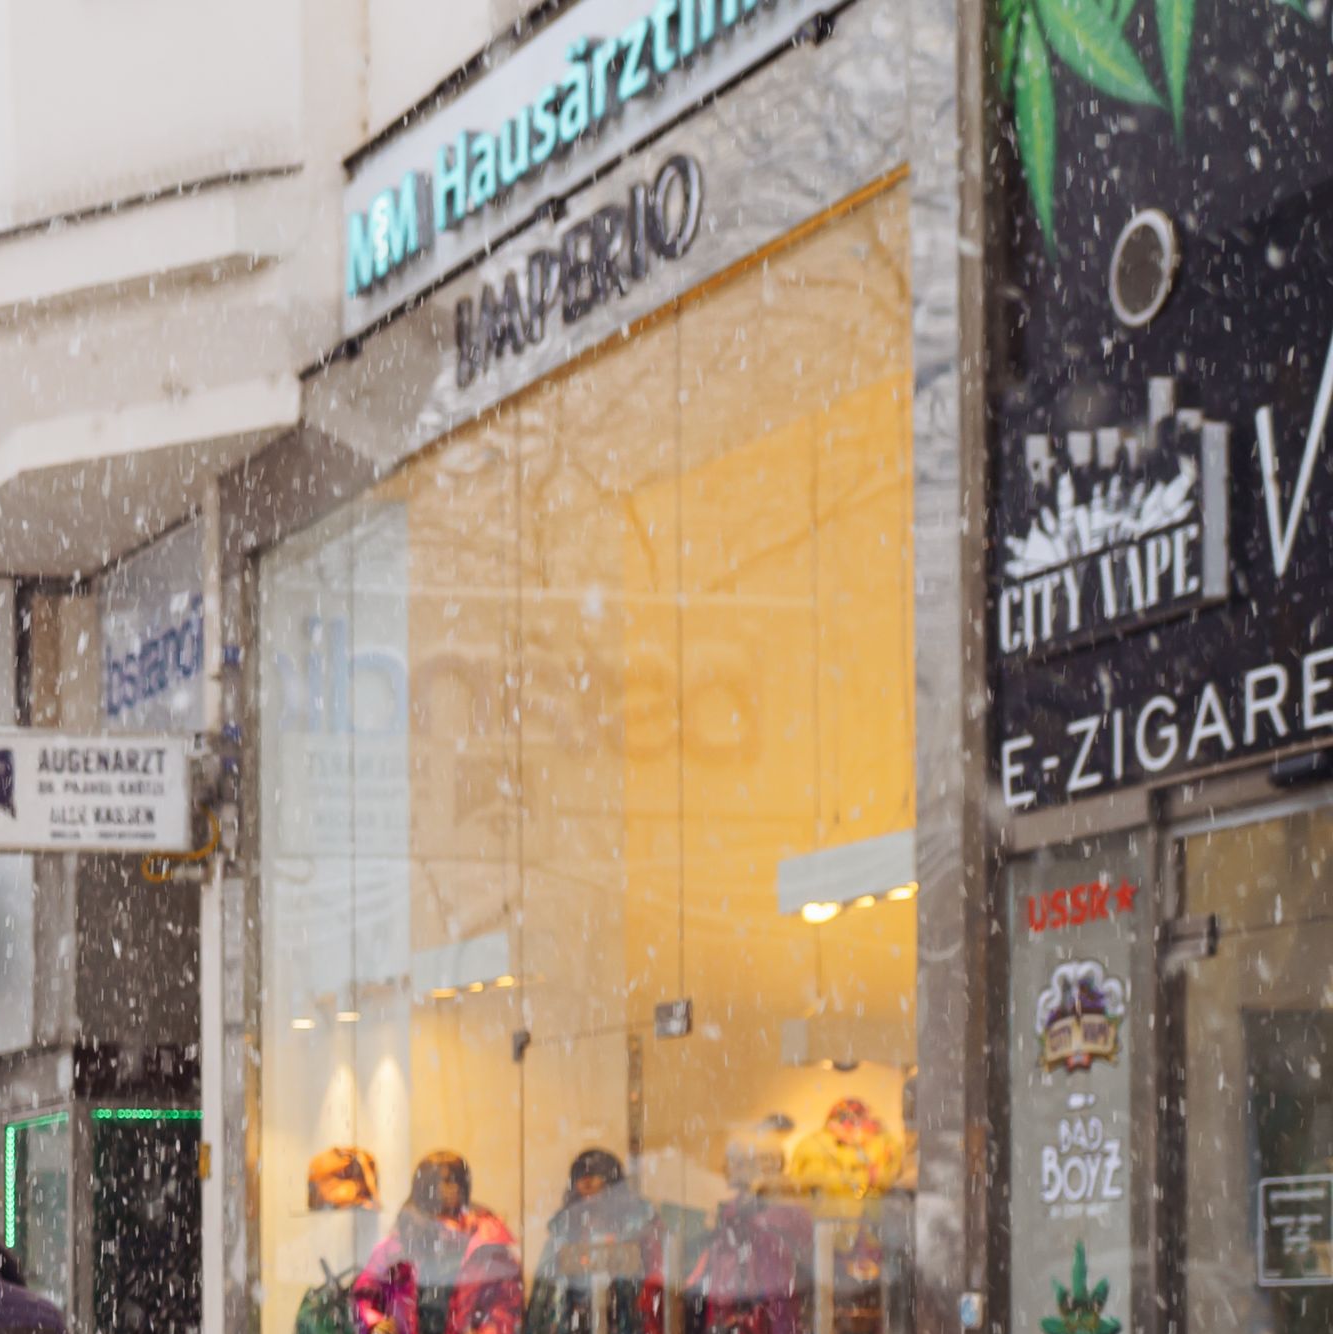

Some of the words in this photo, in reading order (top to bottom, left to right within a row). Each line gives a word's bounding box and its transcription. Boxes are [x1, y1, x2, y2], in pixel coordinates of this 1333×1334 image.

[454, 152, 705, 390] IMPERIO
[998, 563, 1085, 655] CITY
[37, 747, 166, 775] AUGENARZT
[1027, 882, 1111, 933] USSR
[1059, 1115, 1104, 1154] BAD
[1040, 1138, 1124, 1203] BOYZ
